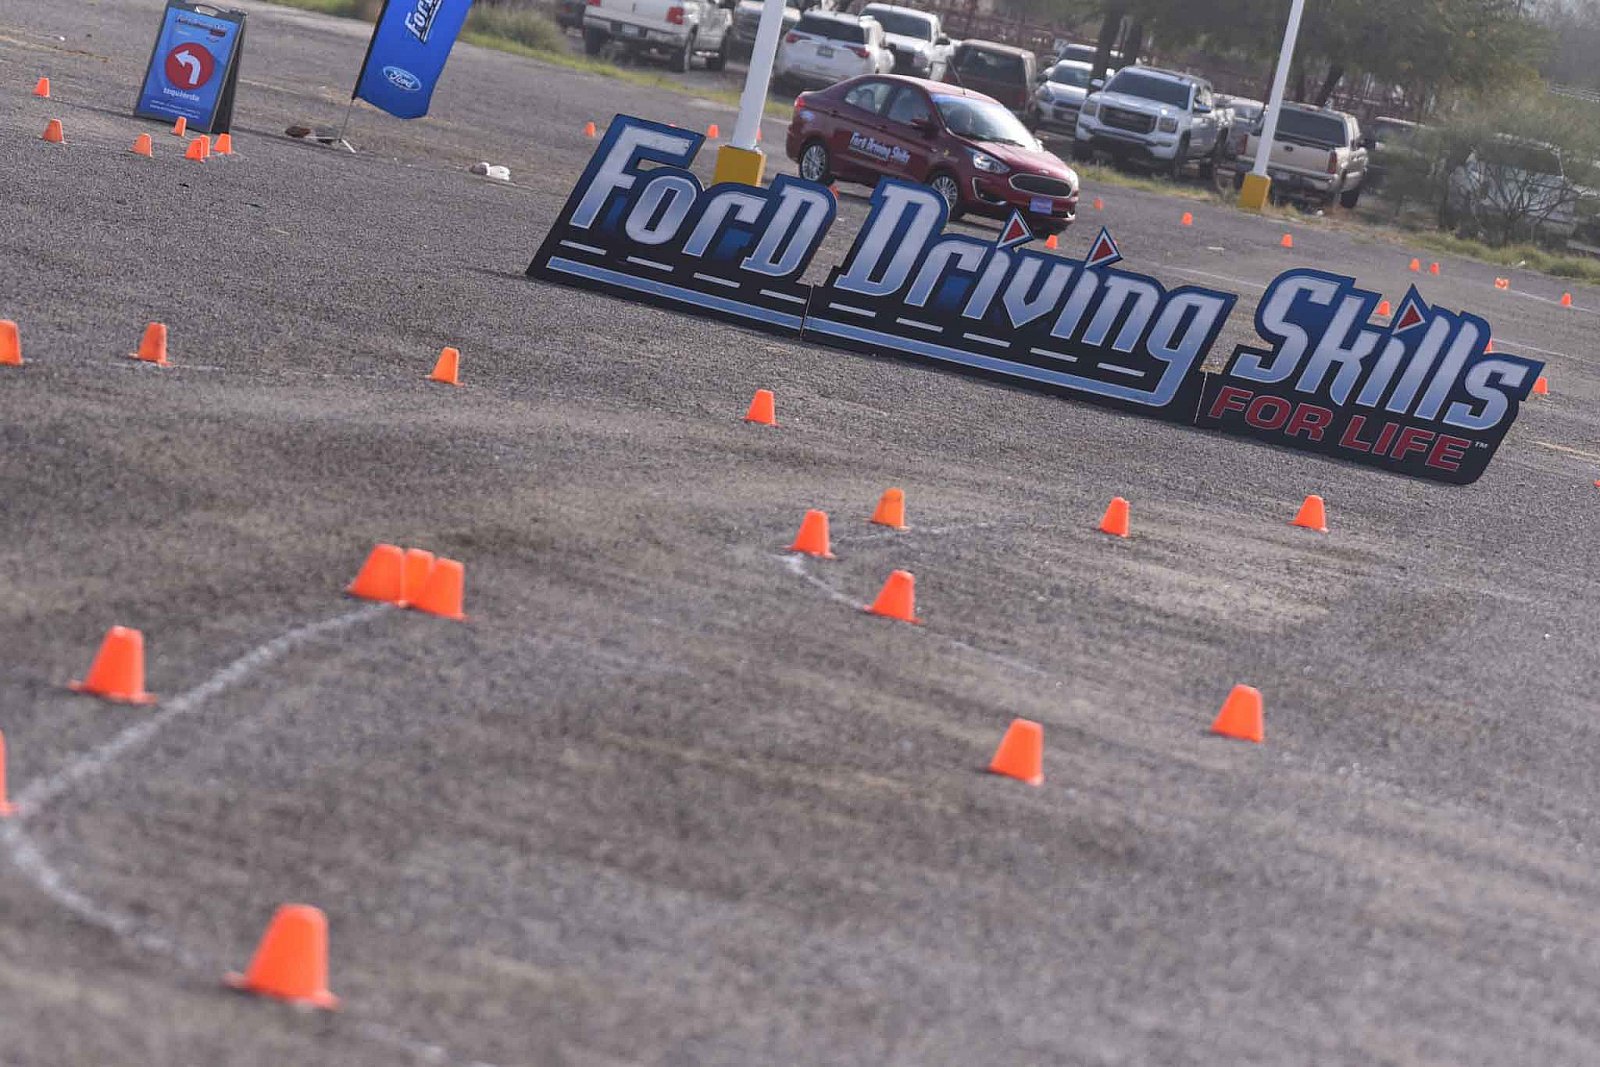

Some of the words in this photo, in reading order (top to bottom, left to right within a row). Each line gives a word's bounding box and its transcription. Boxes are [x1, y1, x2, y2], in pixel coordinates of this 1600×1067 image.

[387, 69, 417, 89] Ford
[834, 178, 1225, 407] Driving
[1230, 275, 1529, 430] Skills
[1208, 386, 1333, 441] FOR
[1339, 415, 1471, 472] LIFE
